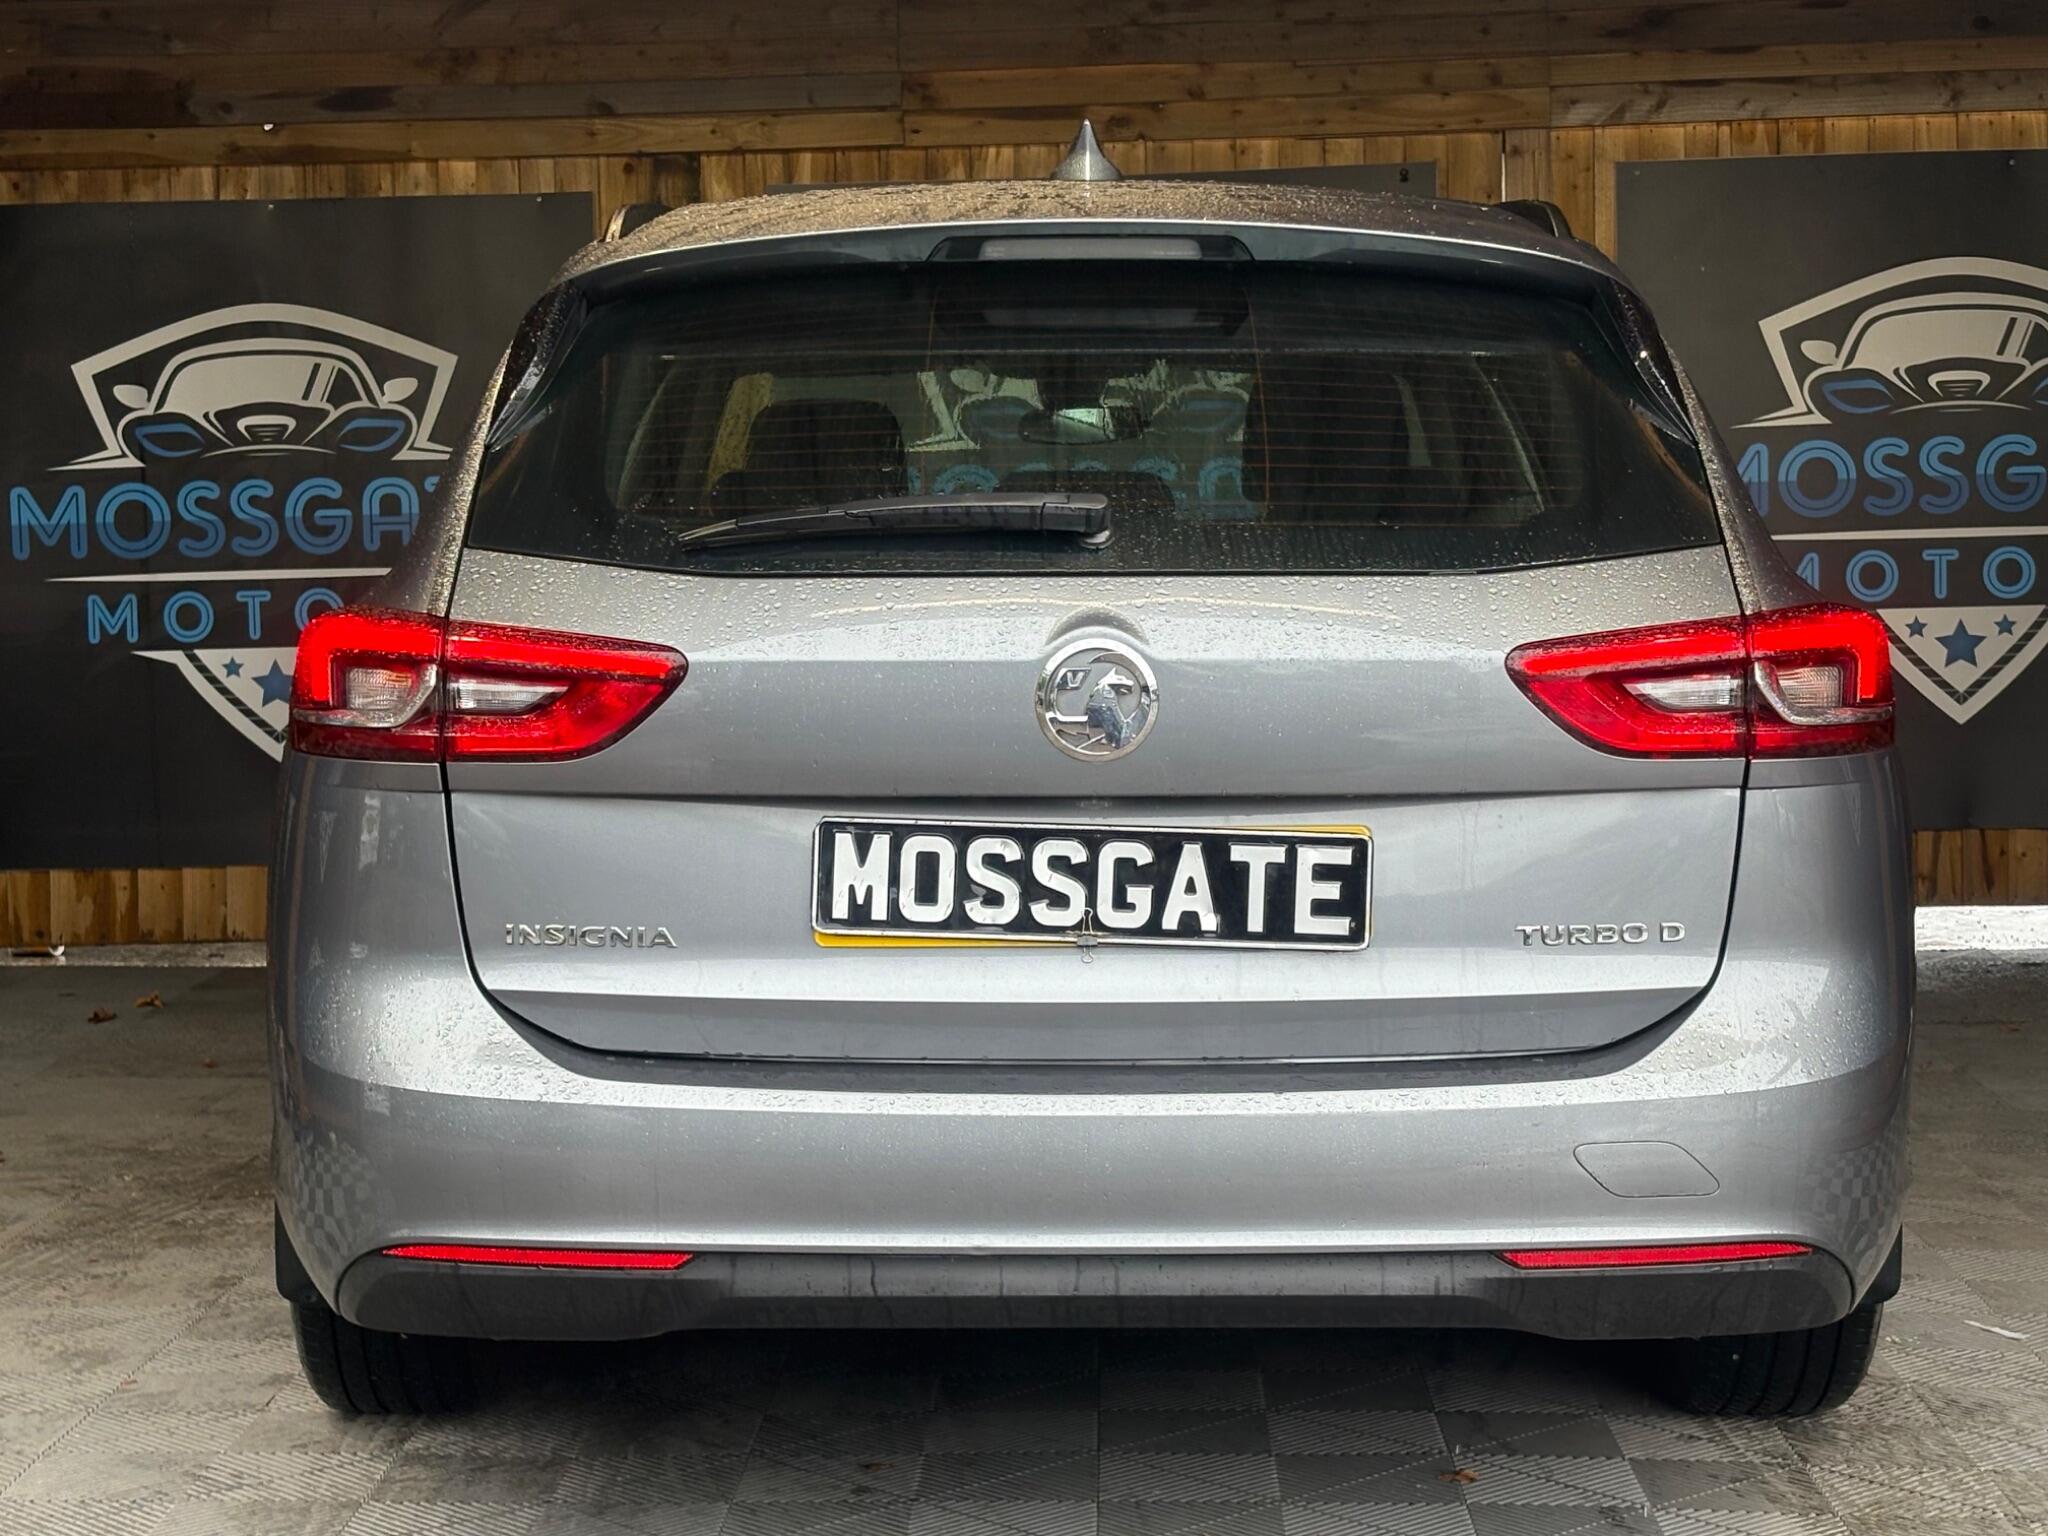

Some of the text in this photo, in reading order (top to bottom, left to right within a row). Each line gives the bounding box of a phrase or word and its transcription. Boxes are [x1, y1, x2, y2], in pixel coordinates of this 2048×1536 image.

[11, 477, 440, 559] MOSSGA
[832, 832, 1353, 935] MOSSGATE
[505, 923, 677, 948] INSIGNIA
[1515, 921, 1686, 946] TURBO D
